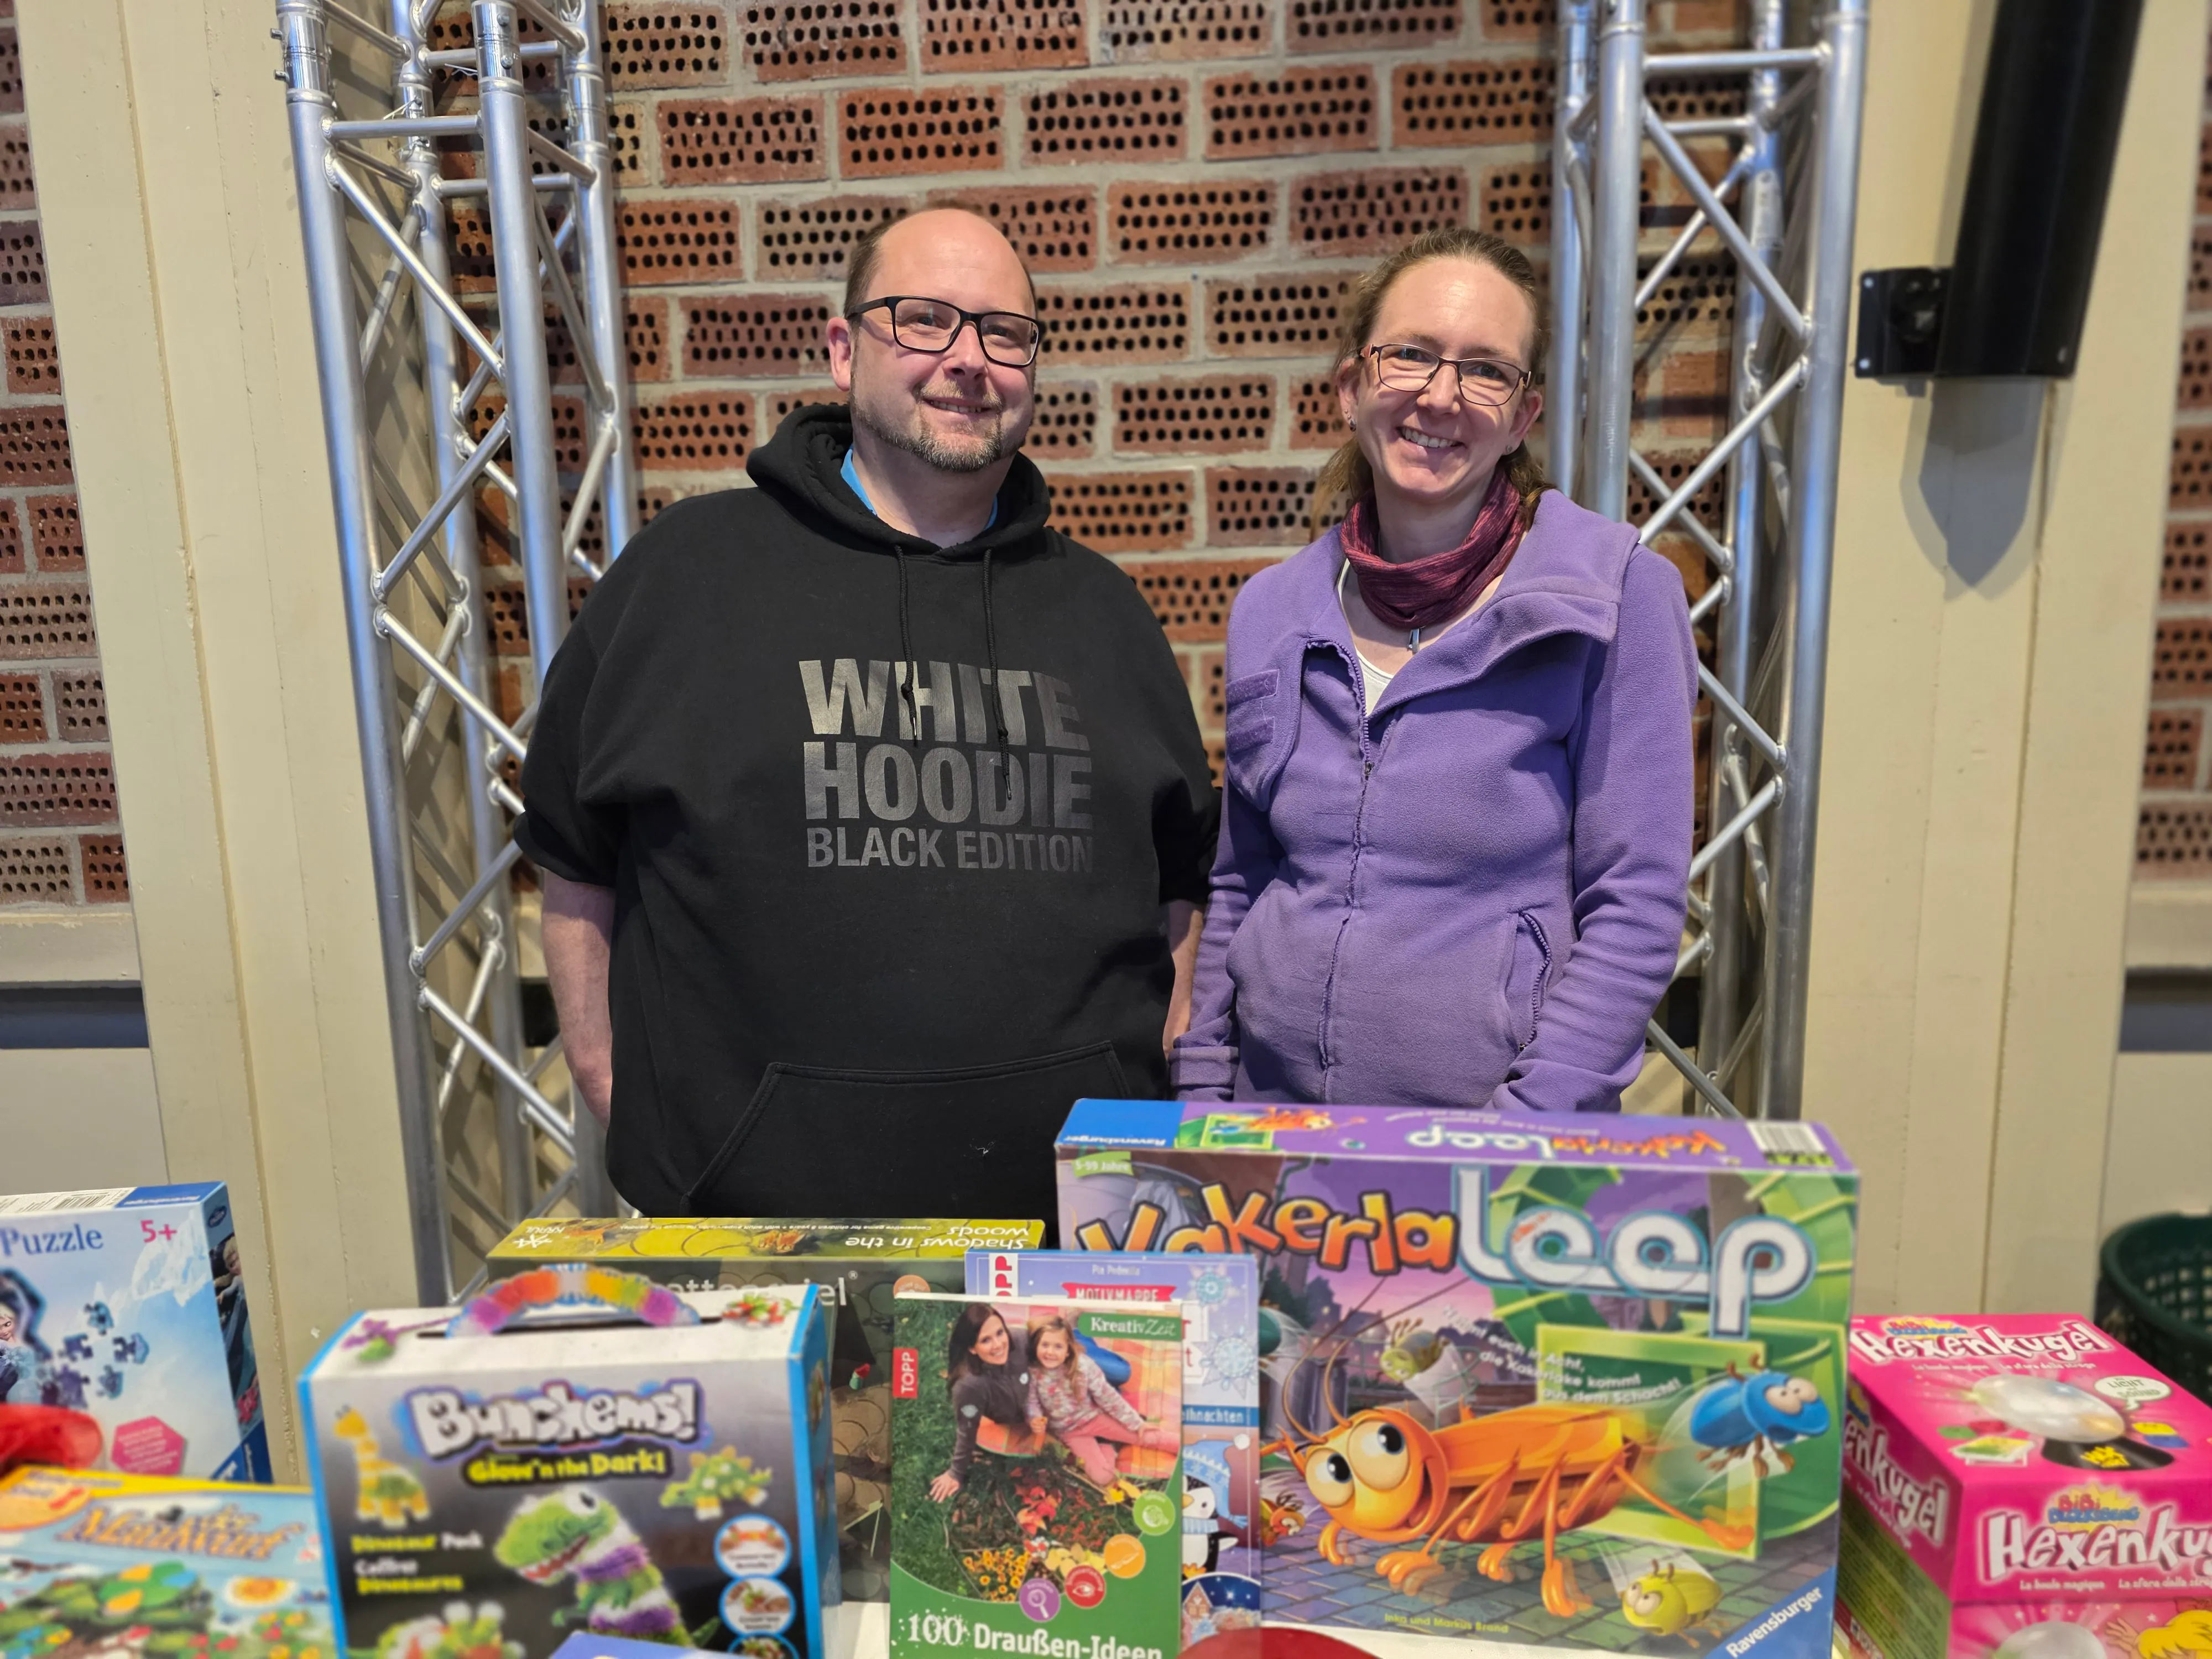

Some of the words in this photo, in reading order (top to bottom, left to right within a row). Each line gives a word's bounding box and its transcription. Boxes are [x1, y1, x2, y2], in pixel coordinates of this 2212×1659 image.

[799, 658, 1090, 751] WHITE
[804, 741, 1092, 829] HOODIE
[807, 827, 945, 868] BLACK
[957, 830, 1093, 873] EDITION
[1065, 1135, 1166, 1146] Ravensburger
[1, 1223, 104, 1256] Puzzle
[140, 1220, 178, 1243] 5+
[844, 1237, 884, 1249] the
[892, 1237, 914, 1249] in
[920, 1238, 1029, 1250] Shadows
[946, 1227, 1030, 1237] woods
[1850, 1322, 2111, 1363] Hexenkugel
[901, 1352, 915, 1394] TOPP
[1587, 1374, 1641, 1388] kommt
[408, 1382, 698, 1457] Bunchems!
[1844, 1420, 1948, 1546] enkugel
[1985, 1505, 2212, 1582] Hexenku
[907, 1613, 964, 1646] 100
[973, 1622, 1162, 1659] Draußen-Ideen
[1725, 1586, 1824, 1658] Ravensburger
